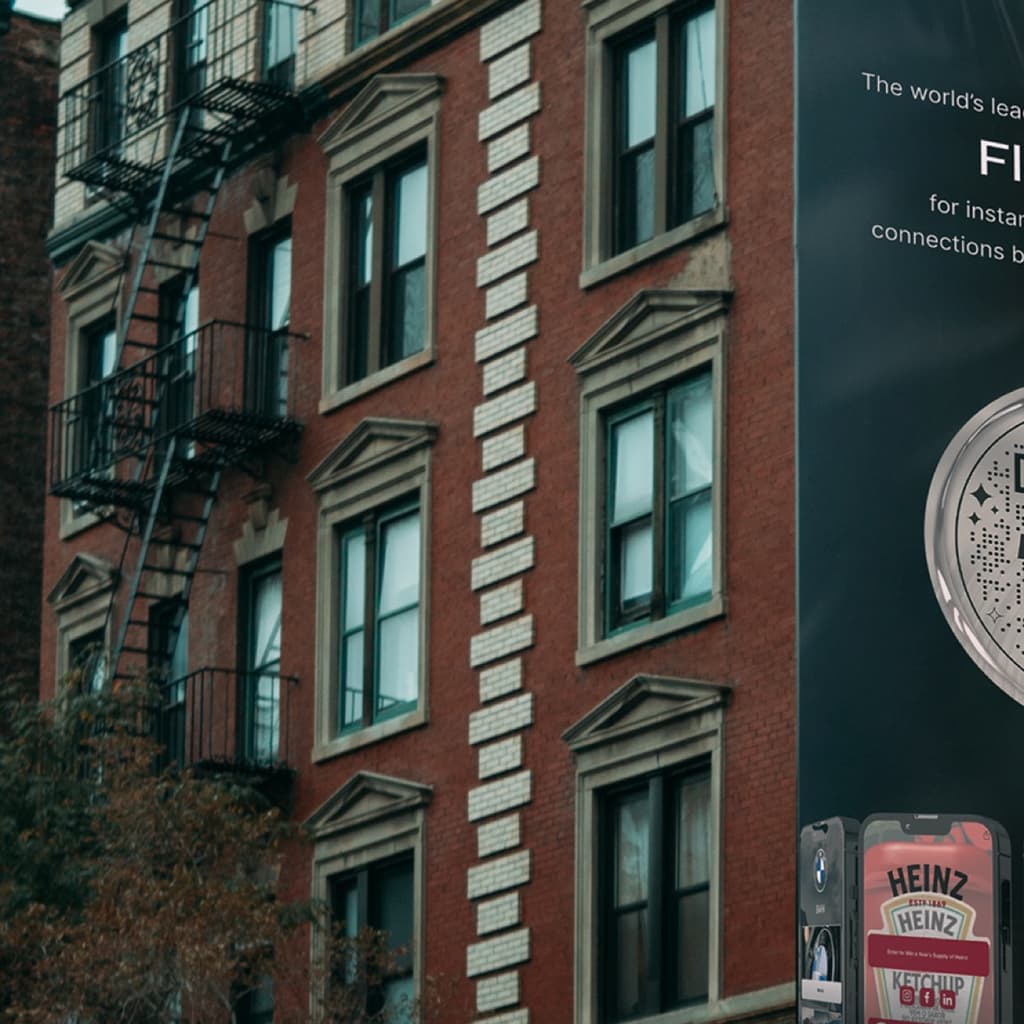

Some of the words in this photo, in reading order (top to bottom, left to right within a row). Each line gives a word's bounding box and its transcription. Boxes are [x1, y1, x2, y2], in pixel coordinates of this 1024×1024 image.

[861, 72, 902, 97] The
[909, 86, 984, 113] world’s
[929, 193, 960, 218] for
[871, 224, 1005, 261] connections
[887, 864, 968, 901] HEINZ
[897, 909, 958, 937] HEINZ
[892, 970, 964, 996] KETCHUP
